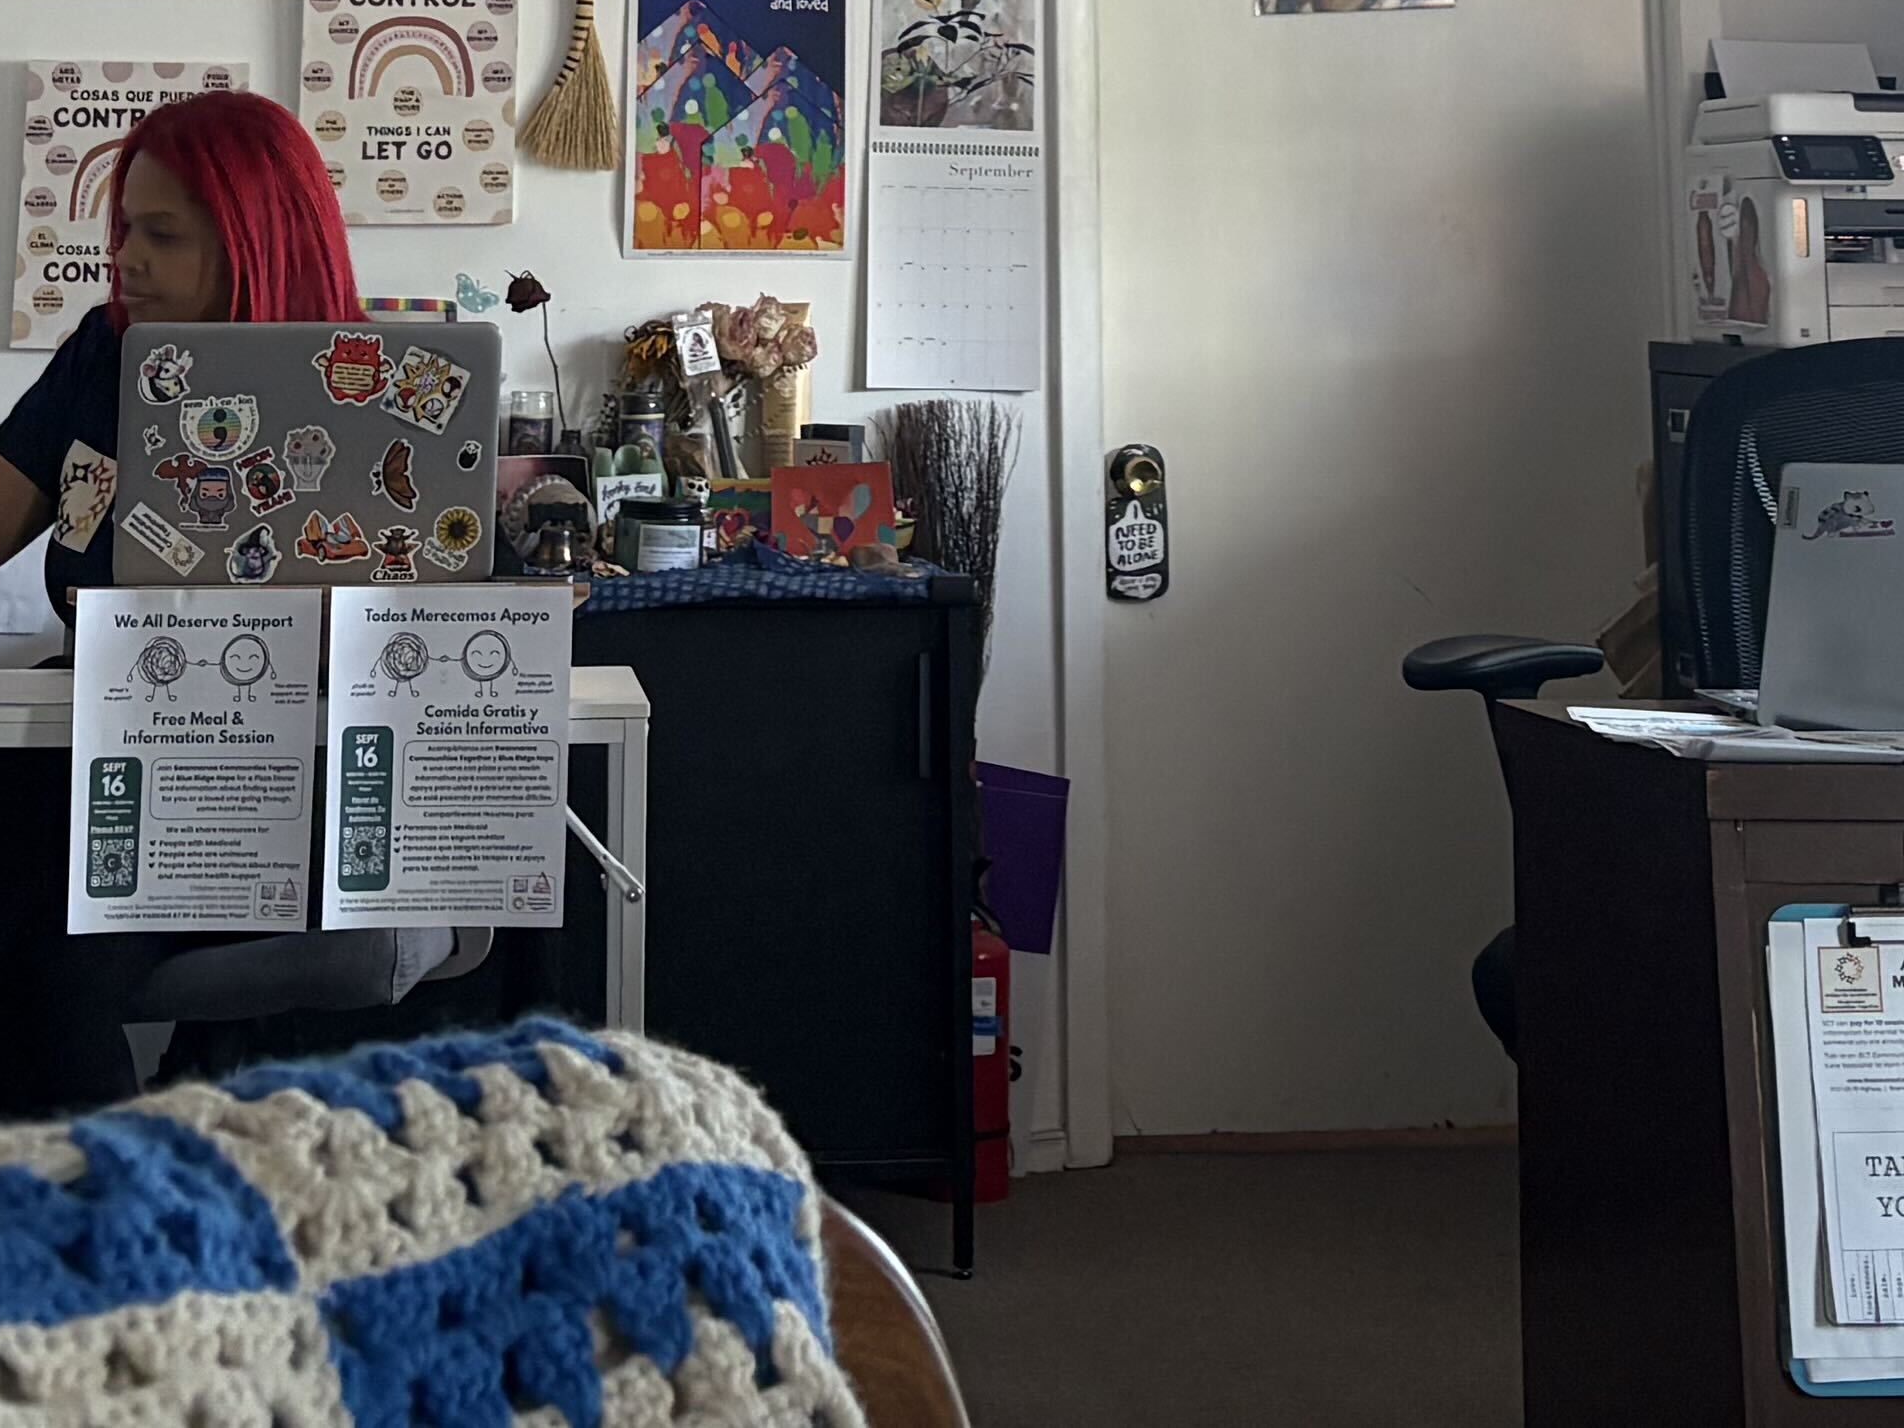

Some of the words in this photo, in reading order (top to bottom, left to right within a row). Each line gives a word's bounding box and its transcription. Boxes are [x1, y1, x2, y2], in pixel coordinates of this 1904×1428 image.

[70, 90, 120, 102] COSAS
[126, 90, 153, 102] QUE
[366, 126, 412, 137] THINGS
[416, 126, 420, 137] I
[425, 126, 451, 137] CAN
[361, 141, 406, 160] LET
[416, 141, 452, 160] GO
[949, 163, 1034, 181] September
[56, 245, 101, 256] COSAS
[1133, 504, 1138, 520] I
[1115, 523, 1157, 540] NEED
[1117, 540, 1136, 551] TO
[1138, 536, 1155, 550] BE
[1117, 550, 1158, 567] ALONE
[372, 569, 416, 581] Chaos
[114, 614, 139, 628] We
[142, 614, 163, 628] All
[167, 615, 228, 628] Deserve
[232, 614, 293, 631] Support
[365, 608, 407, 623] Todos
[411, 609, 496, 623] Merecemos
[500, 608, 550, 625] Apoyo
[153, 712, 186, 726] Free
[190, 711, 227, 726] Meal
[232, 711, 244, 726] &
[424, 705, 479, 718] Comida
[483, 704, 526, 718] Gratis
[529, 707, 539, 721] y
[416, 721, 462, 736] Sesión
[466, 722, 549, 736] Informativa
[123, 730, 215, 744] Information
[219, 731, 275, 744] Session
[355, 733, 379, 744] SEPT
[355, 747, 378, 768] 16
[103, 762, 127, 773] SEPT
[101, 775, 126, 797] 16
